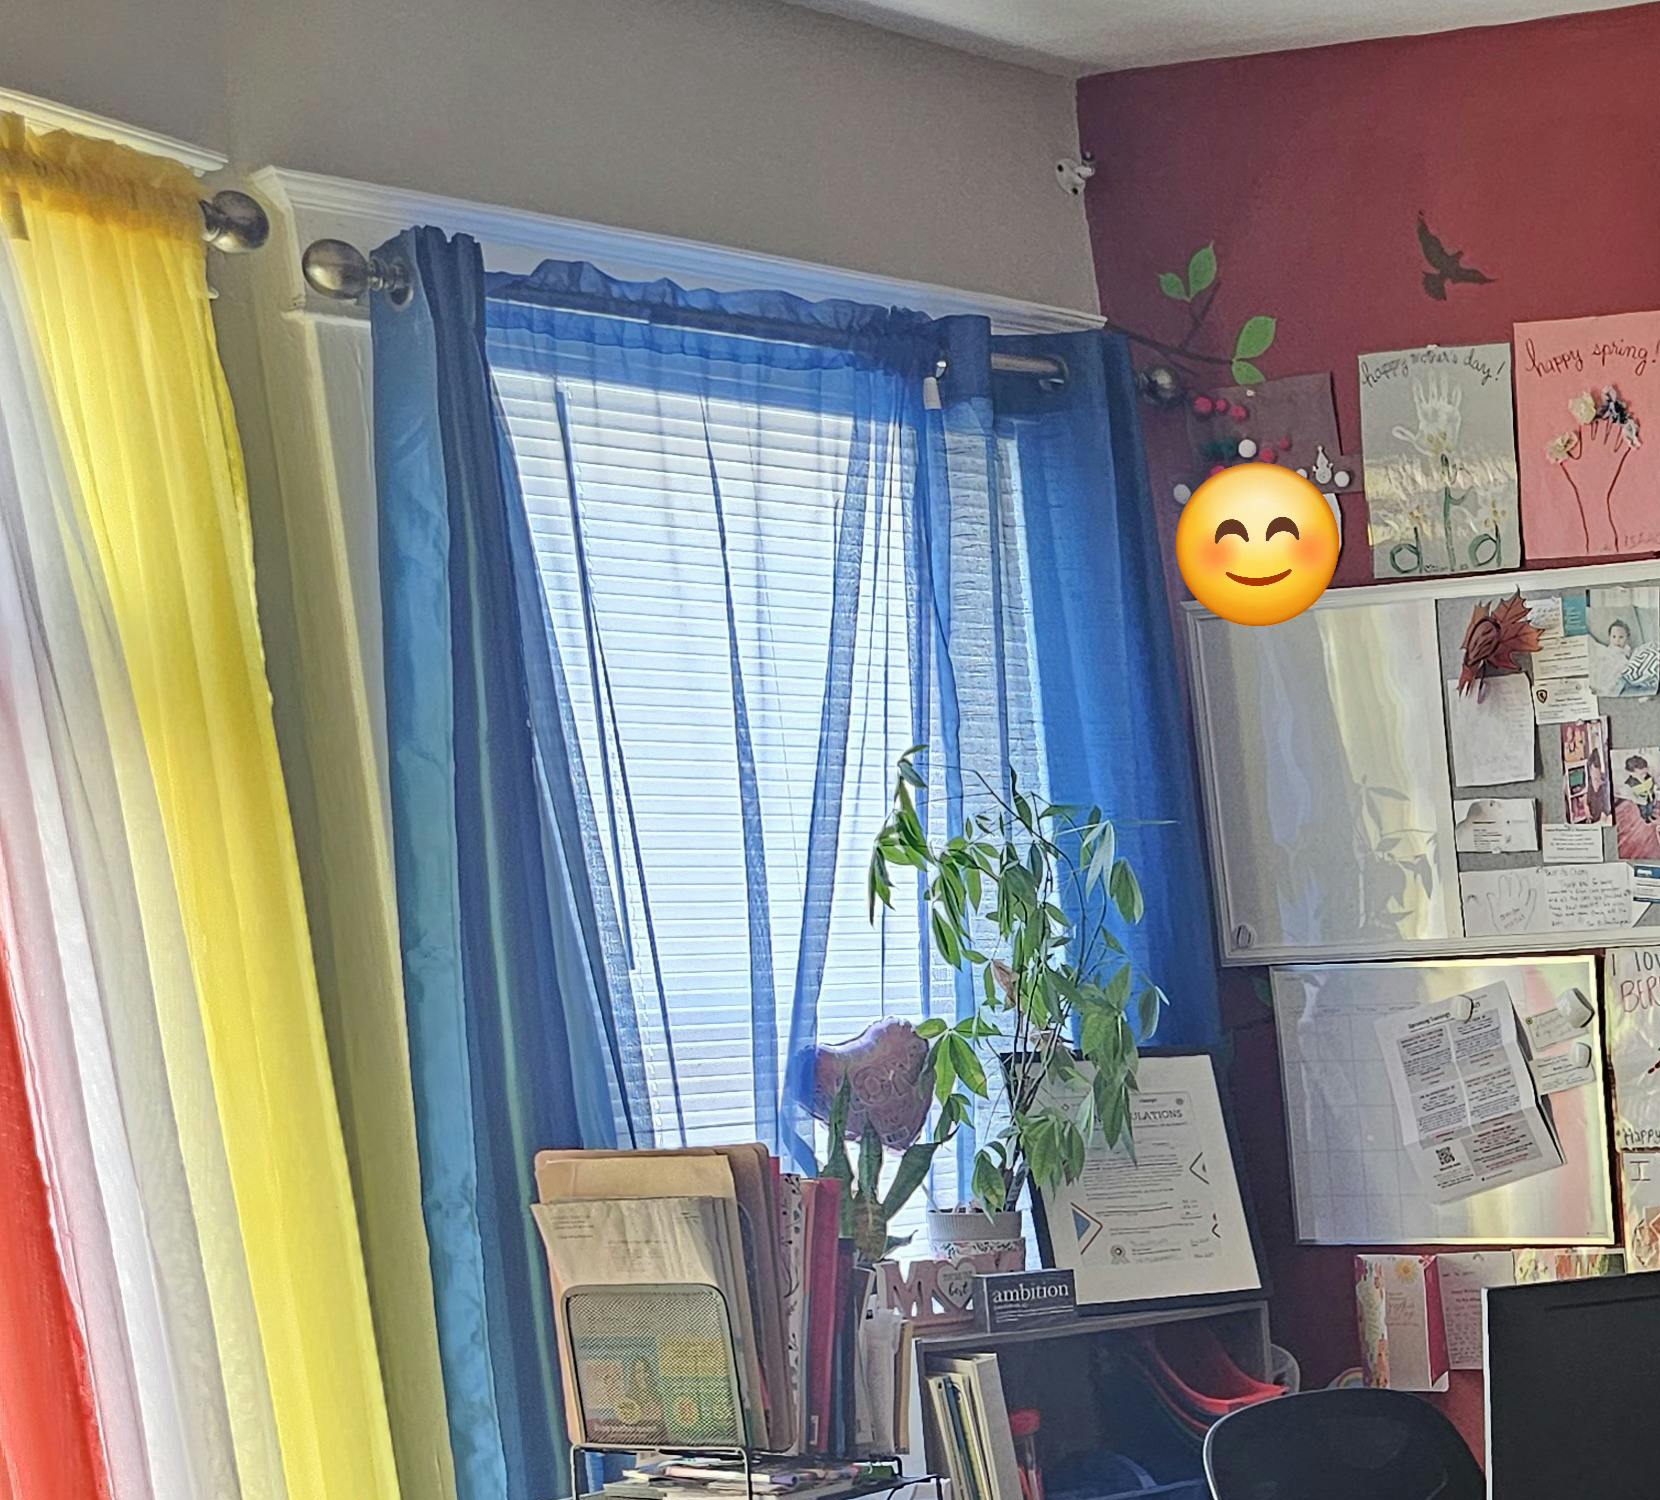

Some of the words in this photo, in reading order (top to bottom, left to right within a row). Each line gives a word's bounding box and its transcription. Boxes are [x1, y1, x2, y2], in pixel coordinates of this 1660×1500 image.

[1362, 357, 1409, 388] happy
[1463, 350, 1504, 386] day!
[1525, 338, 1583, 378] happy
[1611, 954, 1617, 977] I
[1630, 1161, 1651, 1182] I
[992, 1283, 1069, 1304] ambition
